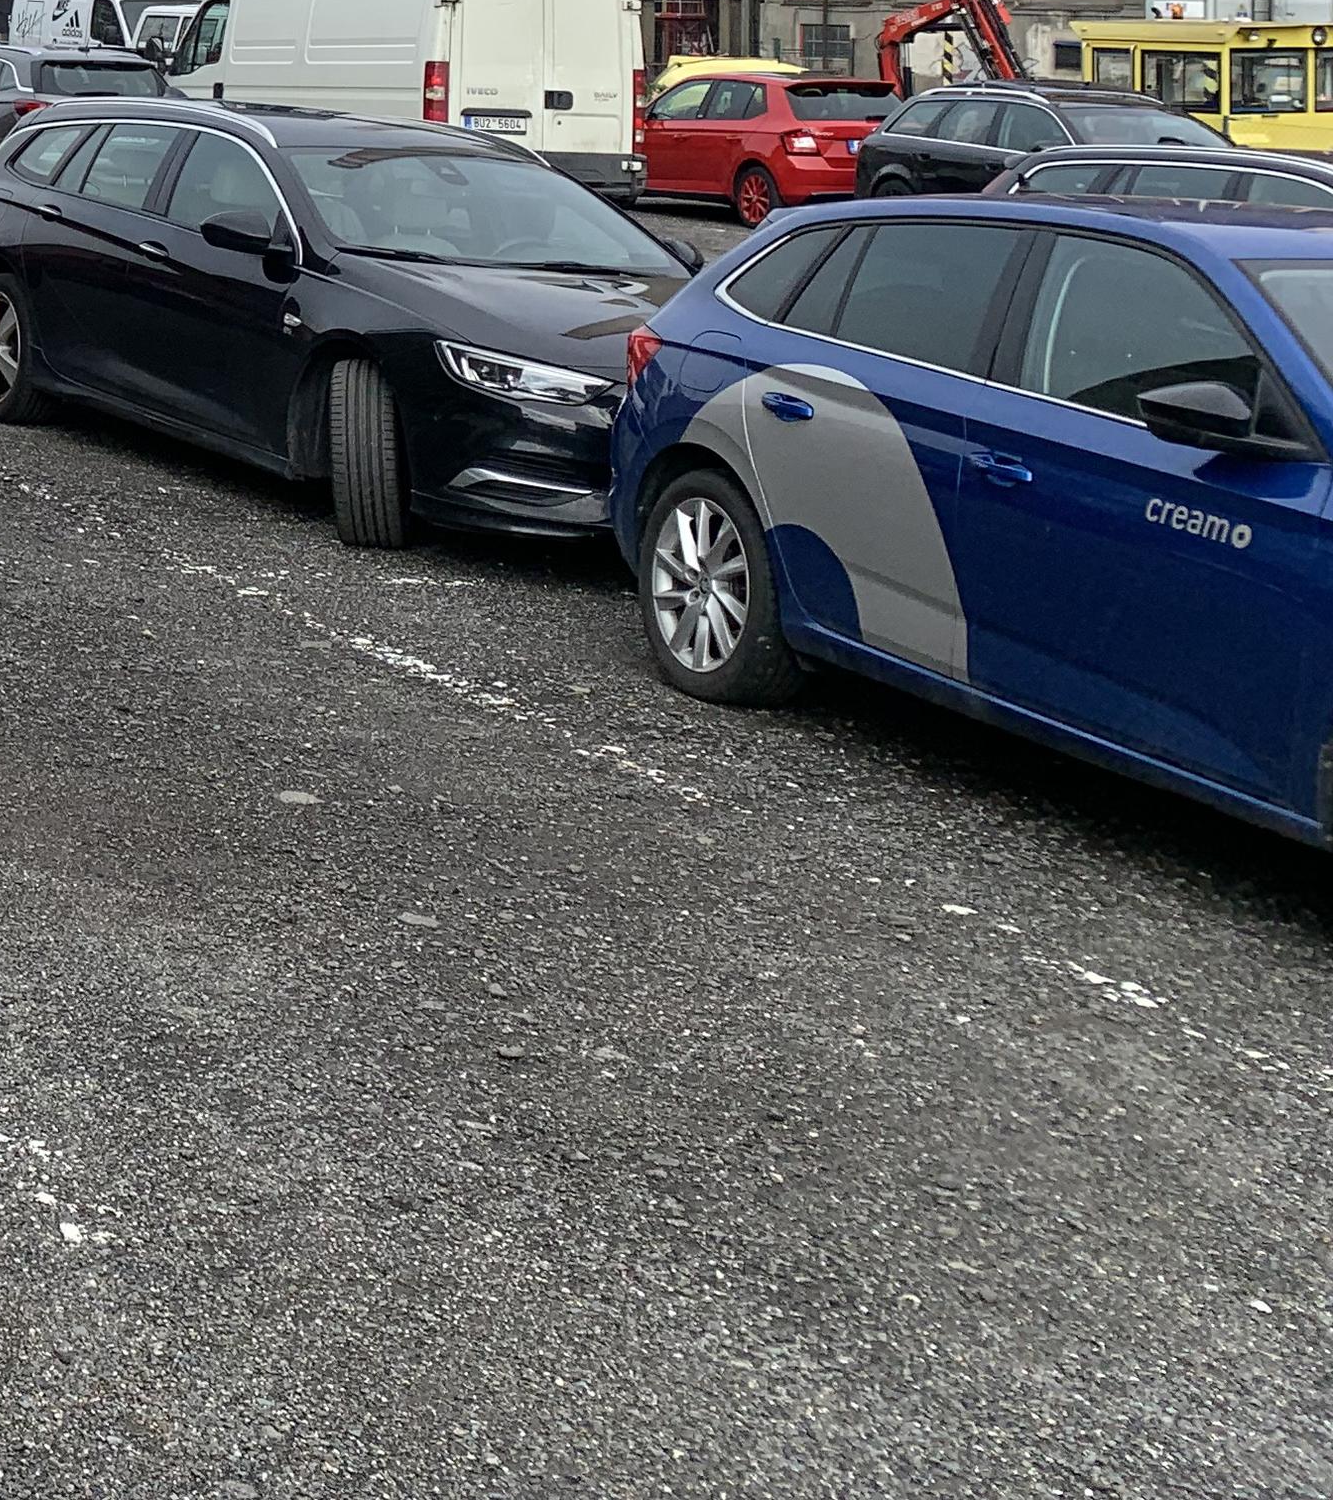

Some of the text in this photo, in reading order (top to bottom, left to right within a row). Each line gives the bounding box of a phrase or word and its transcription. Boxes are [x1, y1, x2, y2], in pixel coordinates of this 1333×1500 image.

[62, 28, 83, 38] adidas
[466, 87, 499, 96] IVECO
[498, 118, 522, 130] 5604
[1145, 498, 1253, 549] creamo
